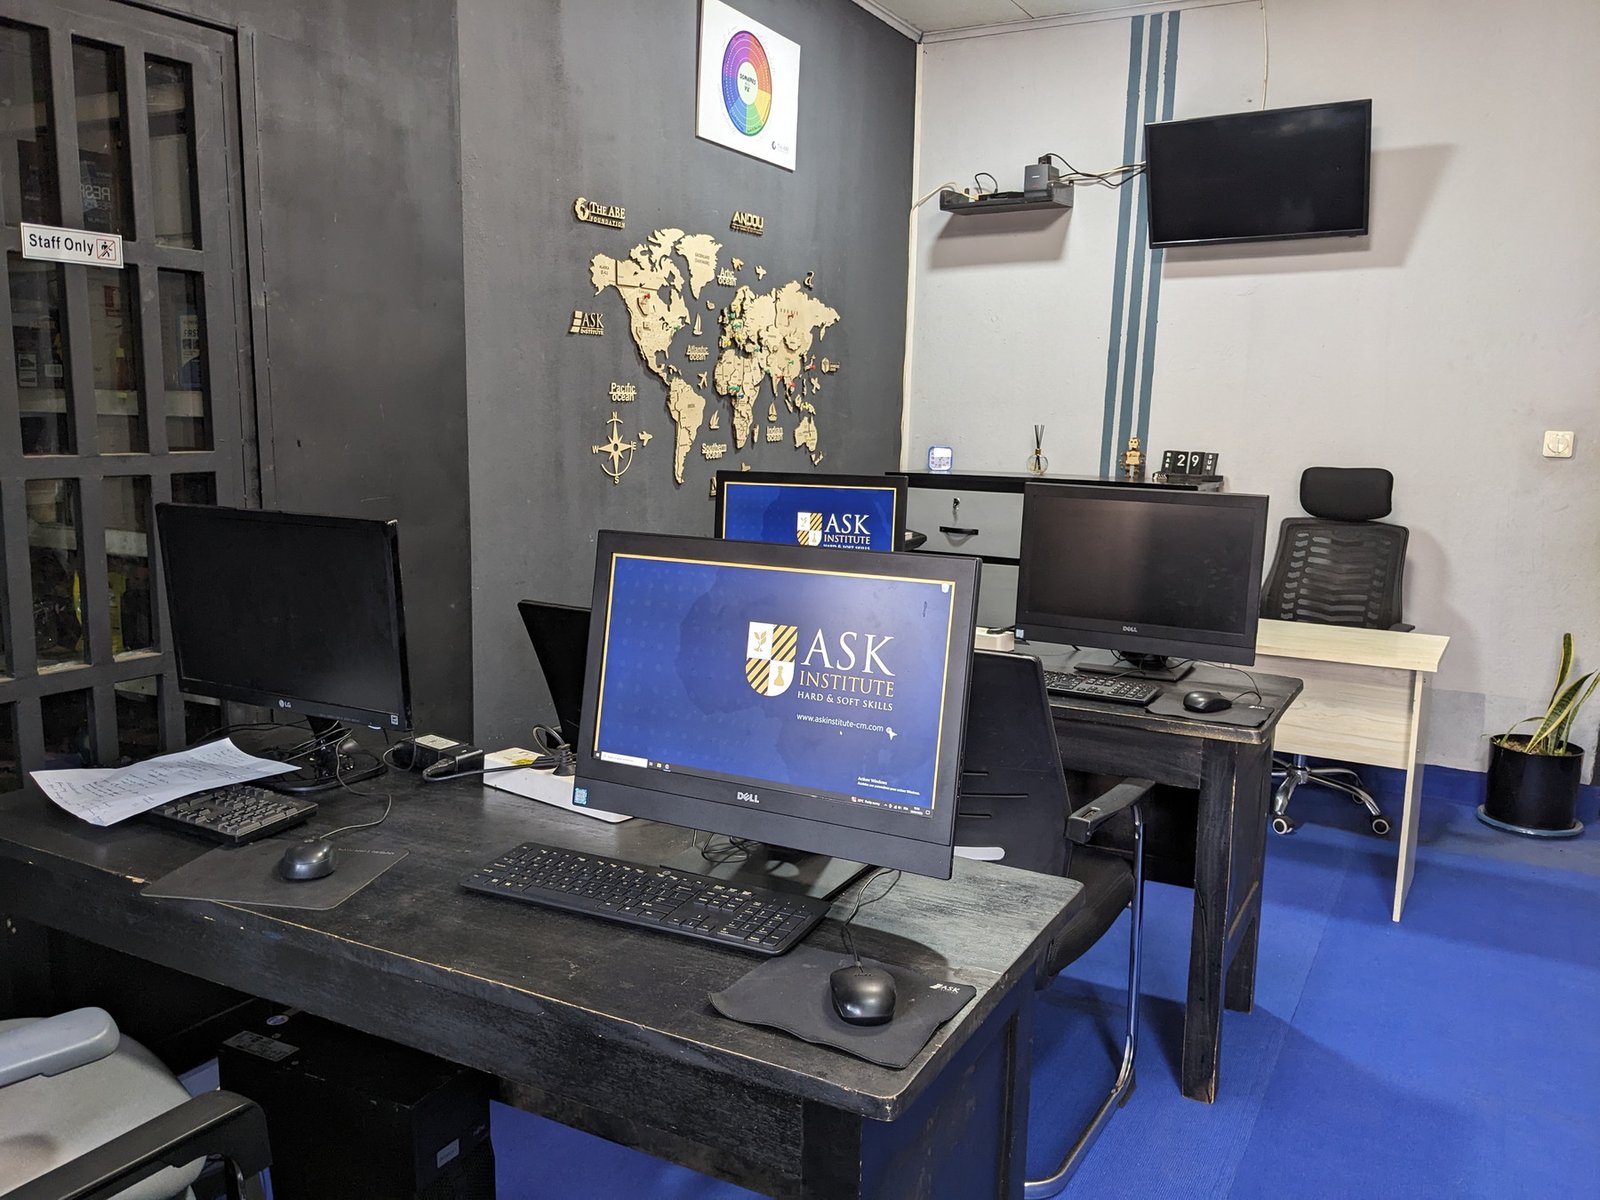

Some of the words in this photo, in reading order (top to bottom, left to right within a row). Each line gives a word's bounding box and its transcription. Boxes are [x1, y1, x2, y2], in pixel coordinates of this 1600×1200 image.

[608, 205, 626, 220] ABE
[29, 233, 61, 250] Staff
[64, 237, 94, 257] Only
[582, 312, 604, 329] ASK
[611, 382, 636, 394] Pacific
[611, 392, 635, 402] ocean
[824, 513, 871, 535] ASK
[823, 533, 871, 544] INSTITUTE
[800, 628, 896, 677] ASK
[799, 670, 895, 698] INSTITUTE
[797, 690, 824, 702] HARD
[826, 695, 834, 704] &
[836, 696, 860, 707] SOFT
[863, 699, 894, 712] SKILLS
[796, 713, 884, 732] www.askinstitute-cm.com
[736, 791, 760, 804] DELL
[941, 985, 961, 995] ASK
